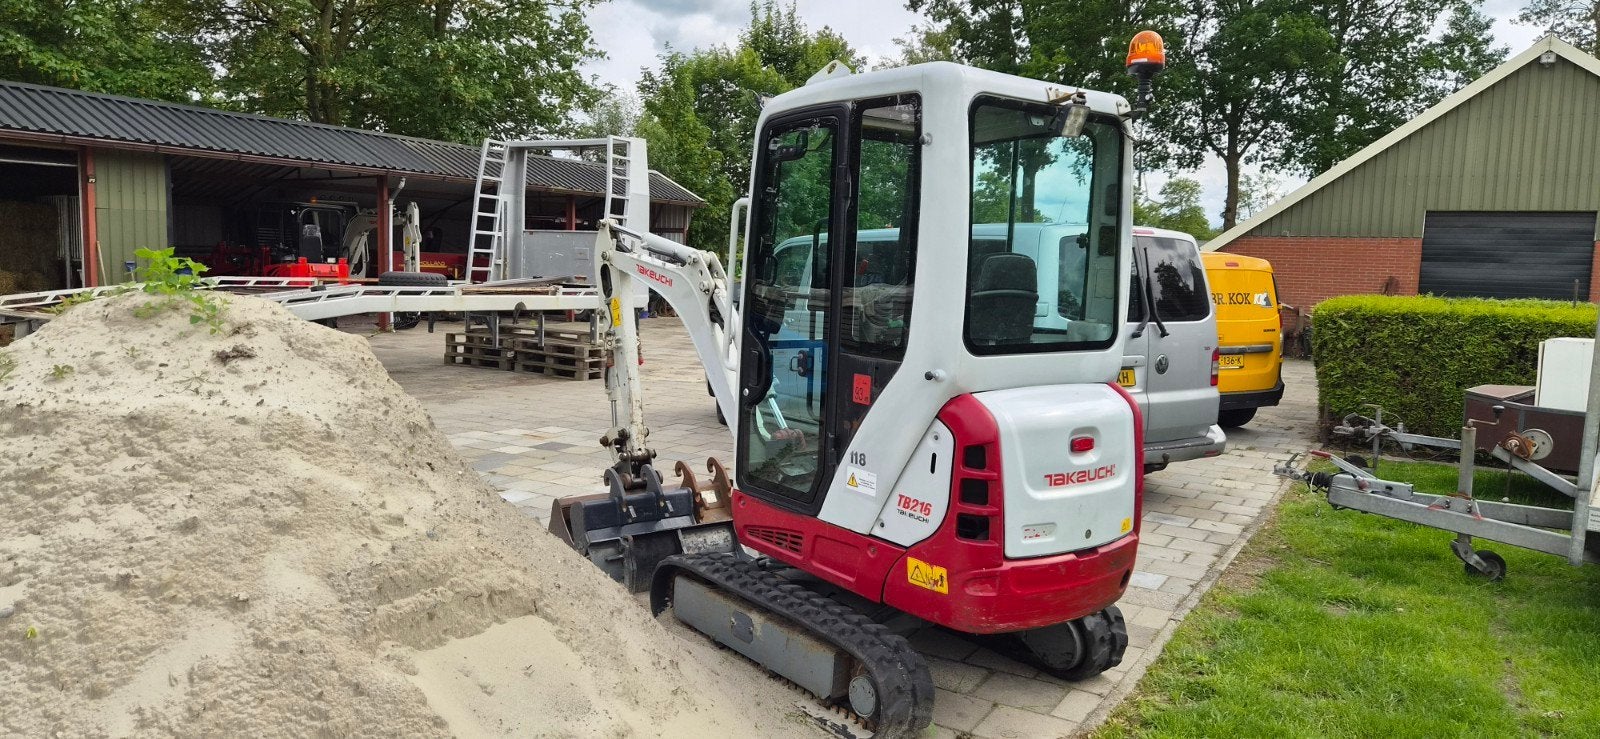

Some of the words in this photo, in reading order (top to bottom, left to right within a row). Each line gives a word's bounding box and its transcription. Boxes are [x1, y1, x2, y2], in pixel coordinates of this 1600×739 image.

[636, 264, 673, 287] TAKEUCHI
[1228, 292, 1251, 305] KOK
[1218, 355, 1242, 366] -136-K
[850, 451, 867, 467] 118
[897, 493, 932, 517] TB216
